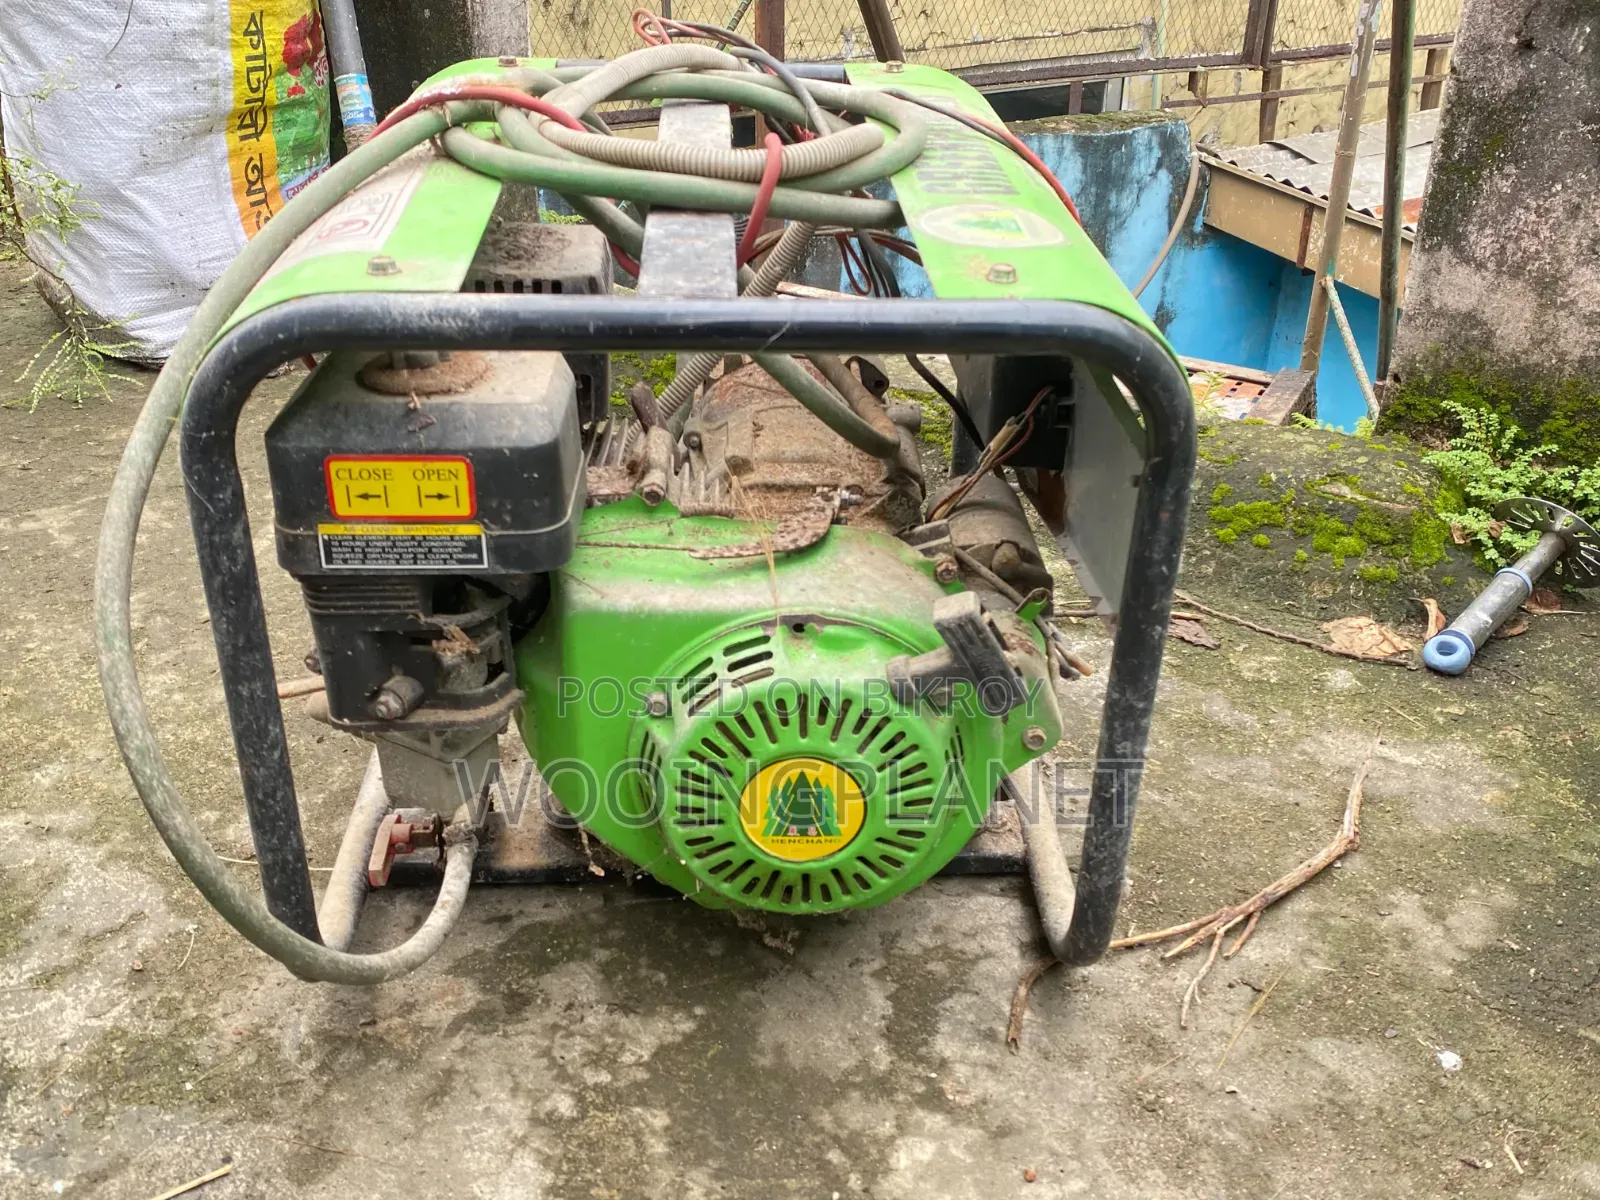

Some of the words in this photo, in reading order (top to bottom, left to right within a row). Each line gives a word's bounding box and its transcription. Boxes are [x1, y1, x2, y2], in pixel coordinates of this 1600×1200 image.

[335, 468, 394, 481] CLOSE
[412, 468, 461, 481] OPEN
[403, 526, 459, 534] MAINTENANCE
